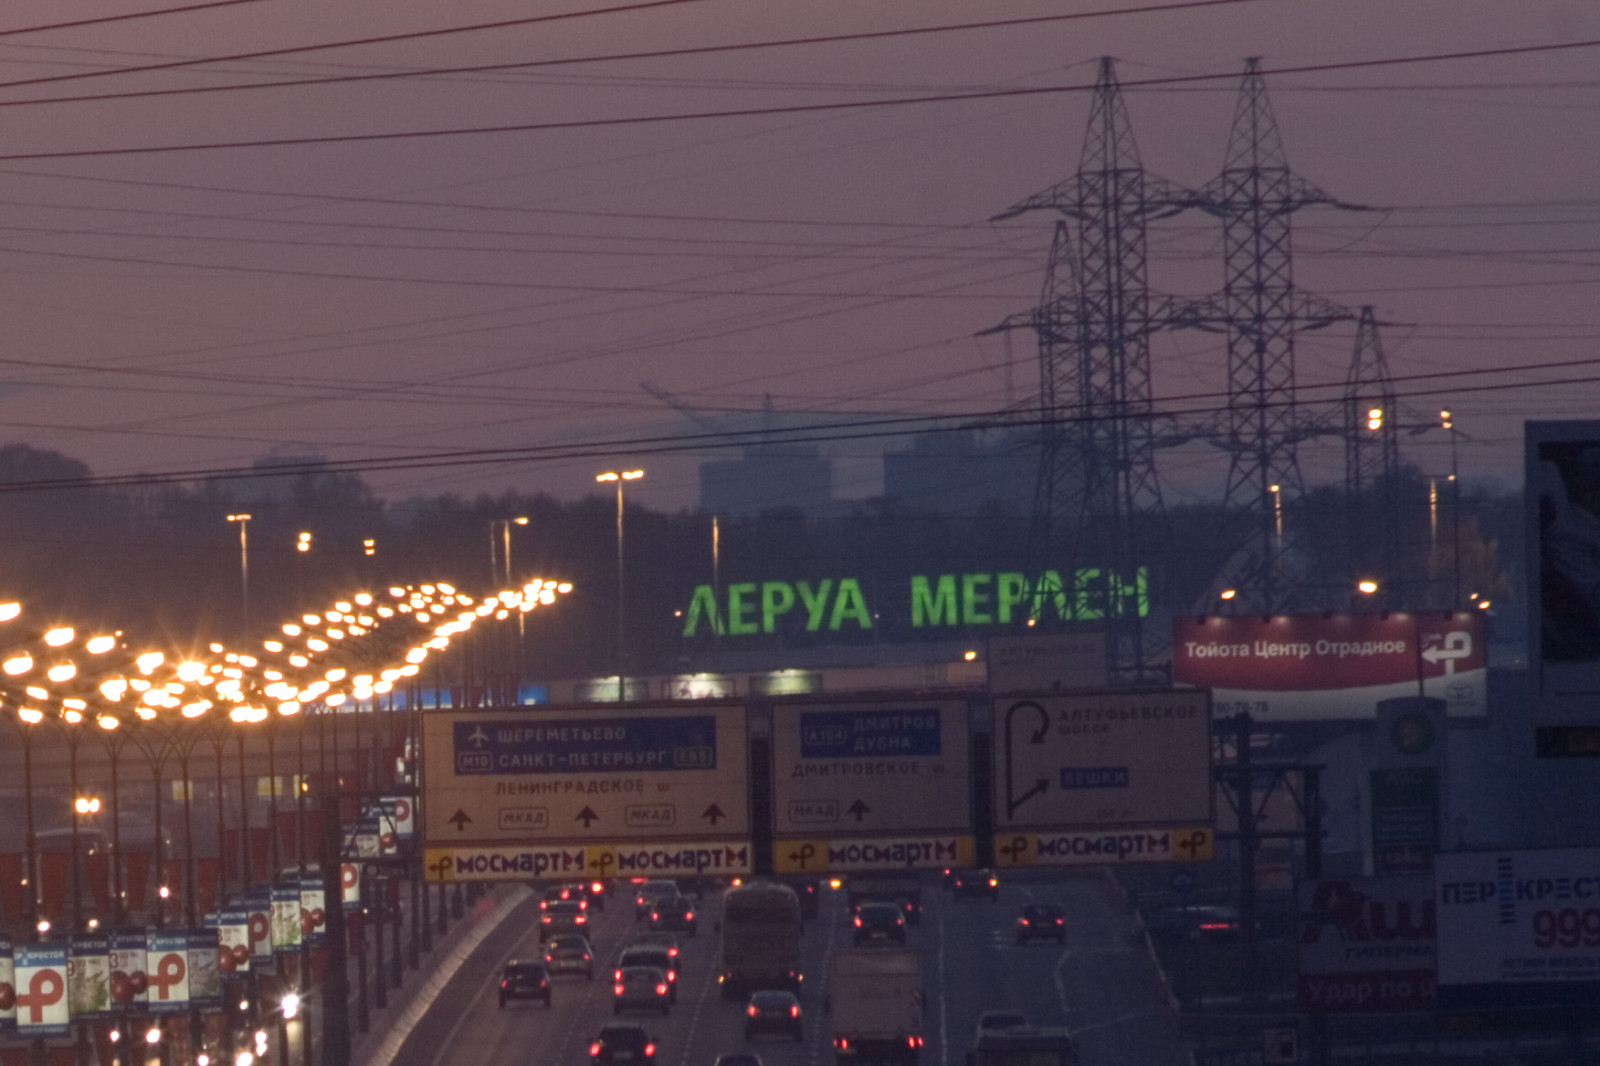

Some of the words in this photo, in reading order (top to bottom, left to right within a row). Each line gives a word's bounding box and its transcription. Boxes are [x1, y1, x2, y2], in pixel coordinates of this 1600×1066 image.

[683, 578, 873, 637] ЛЕРУА
[911, 566, 1149, 628] МЕРЛЕН
[1185, 641, 1249, 659] Тойота
[1254, 640, 1311, 660] Центр
[1315, 639, 1406, 659] Отрадное
[1059, 705, 1198, 721] АЛТУФЬЕВСКОЕ
[853, 715, 936, 732] ДМИТРОВ
[498, 727, 627, 743] ШЕРЕМЕТЬЕВО
[853, 736, 911, 752] ДУБНА
[499, 751, 666, 768] САНКТ-ПЕТЕРБУРГ
[792, 761, 920, 778] ДМИТРОВСКОЕ
[1063, 770, 1125, 785] ВЕШКИ
[495, 779, 644, 796] ЛЕНИНГРАДСКОЕ
[503, 812, 545, 825] МКАД
[630, 809, 672, 823] МКАД
[793, 805, 835, 817] МКАД
[1533, 908, 1600, 949] 999
